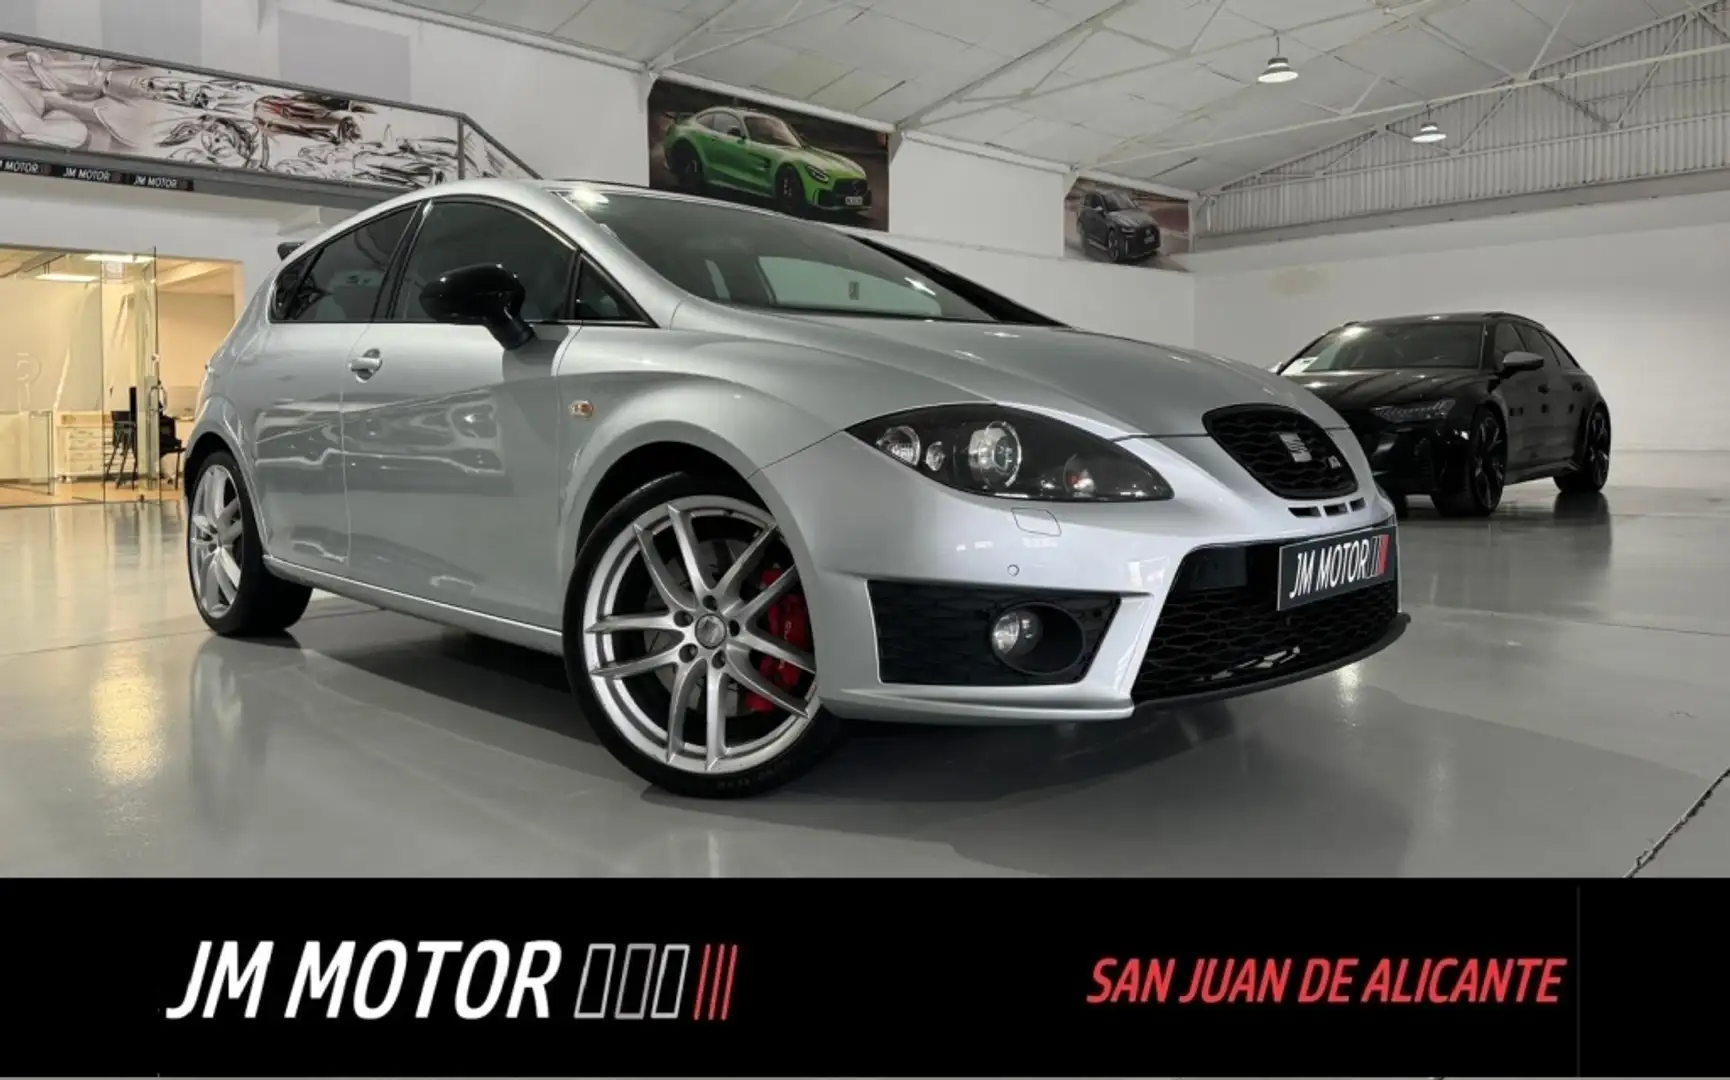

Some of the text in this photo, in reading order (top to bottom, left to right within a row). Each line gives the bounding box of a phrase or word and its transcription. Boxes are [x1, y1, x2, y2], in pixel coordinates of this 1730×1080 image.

[4, 161, 39, 173] MOTOR
[63, 167, 111, 182] JM MOTOR
[133, 174, 178, 188] JM MOTOR
[1289, 539, 1369, 599] JM MOTOR
